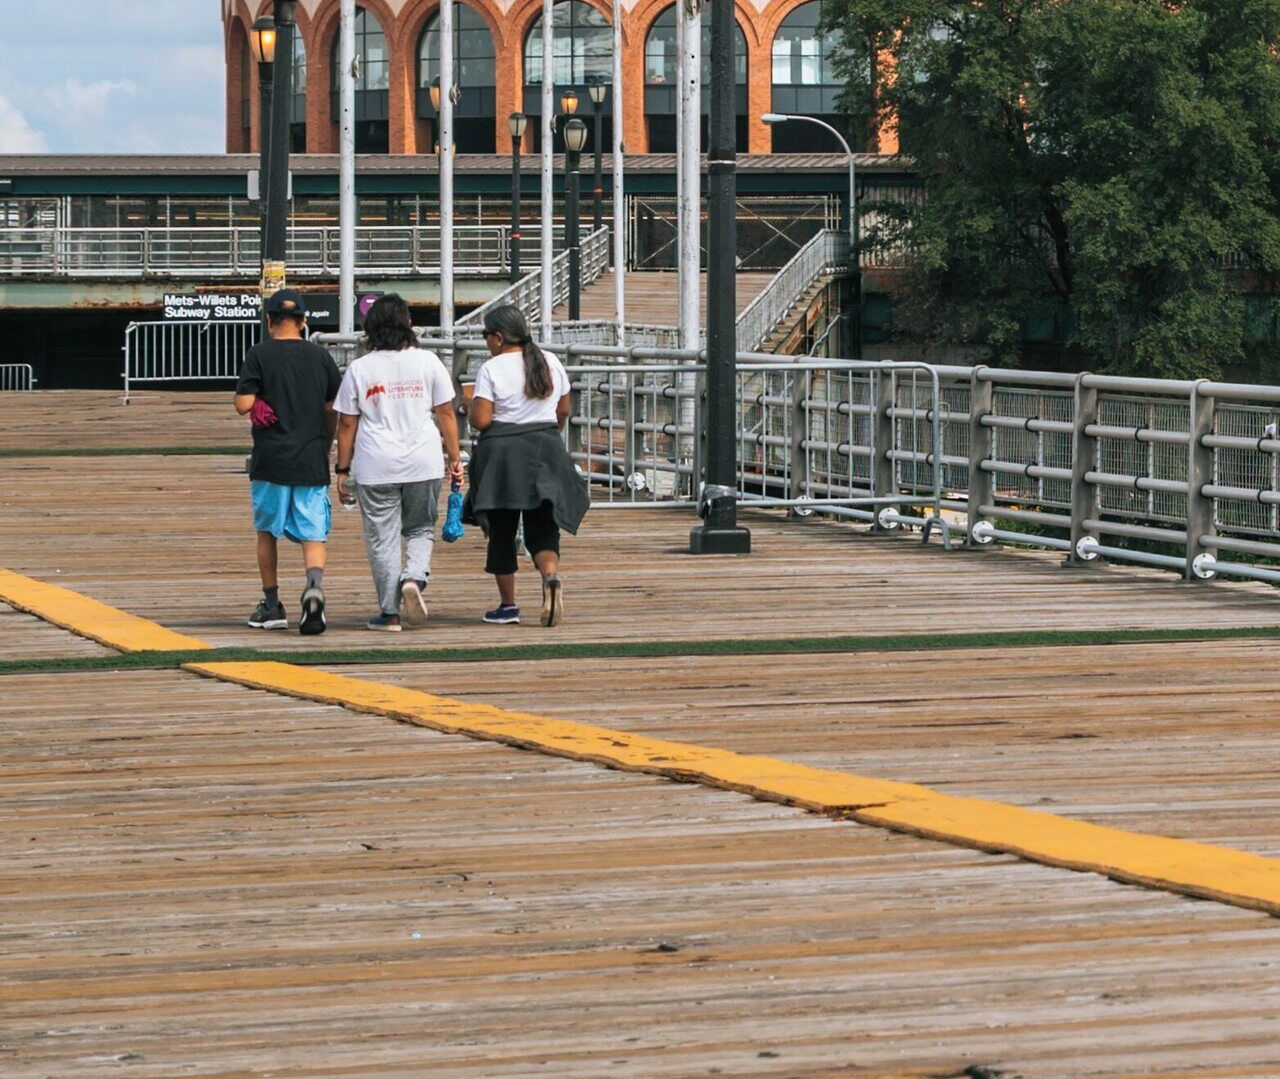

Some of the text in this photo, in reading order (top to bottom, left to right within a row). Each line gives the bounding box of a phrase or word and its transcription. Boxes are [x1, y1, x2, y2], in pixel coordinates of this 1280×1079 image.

[164, 294, 261, 306] Mets-Willets Poi
[164, 306, 257, 320] Subway Station
